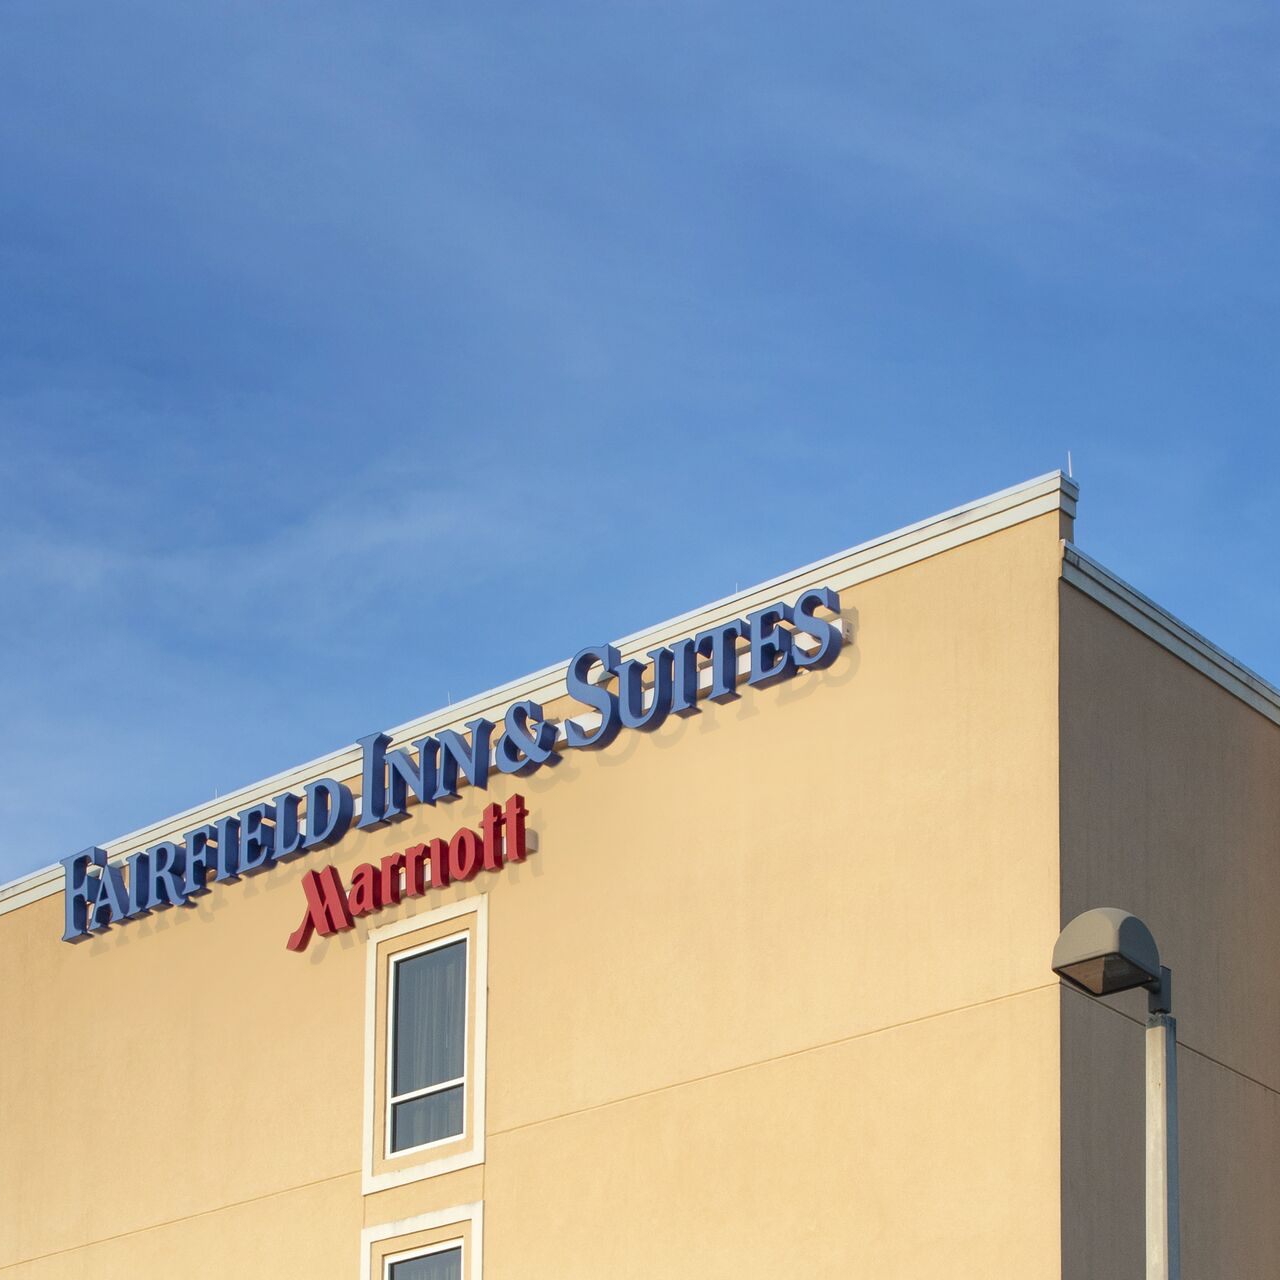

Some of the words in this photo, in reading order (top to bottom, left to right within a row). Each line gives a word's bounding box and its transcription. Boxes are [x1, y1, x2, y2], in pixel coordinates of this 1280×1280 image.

[60, 778, 353, 944] FAIRFIELD
[356, 732, 496, 832] INN
[495, 700, 562, 774] &
[565, 586, 843, 751] SUITES
[286, 793, 528, 952] Marriott
